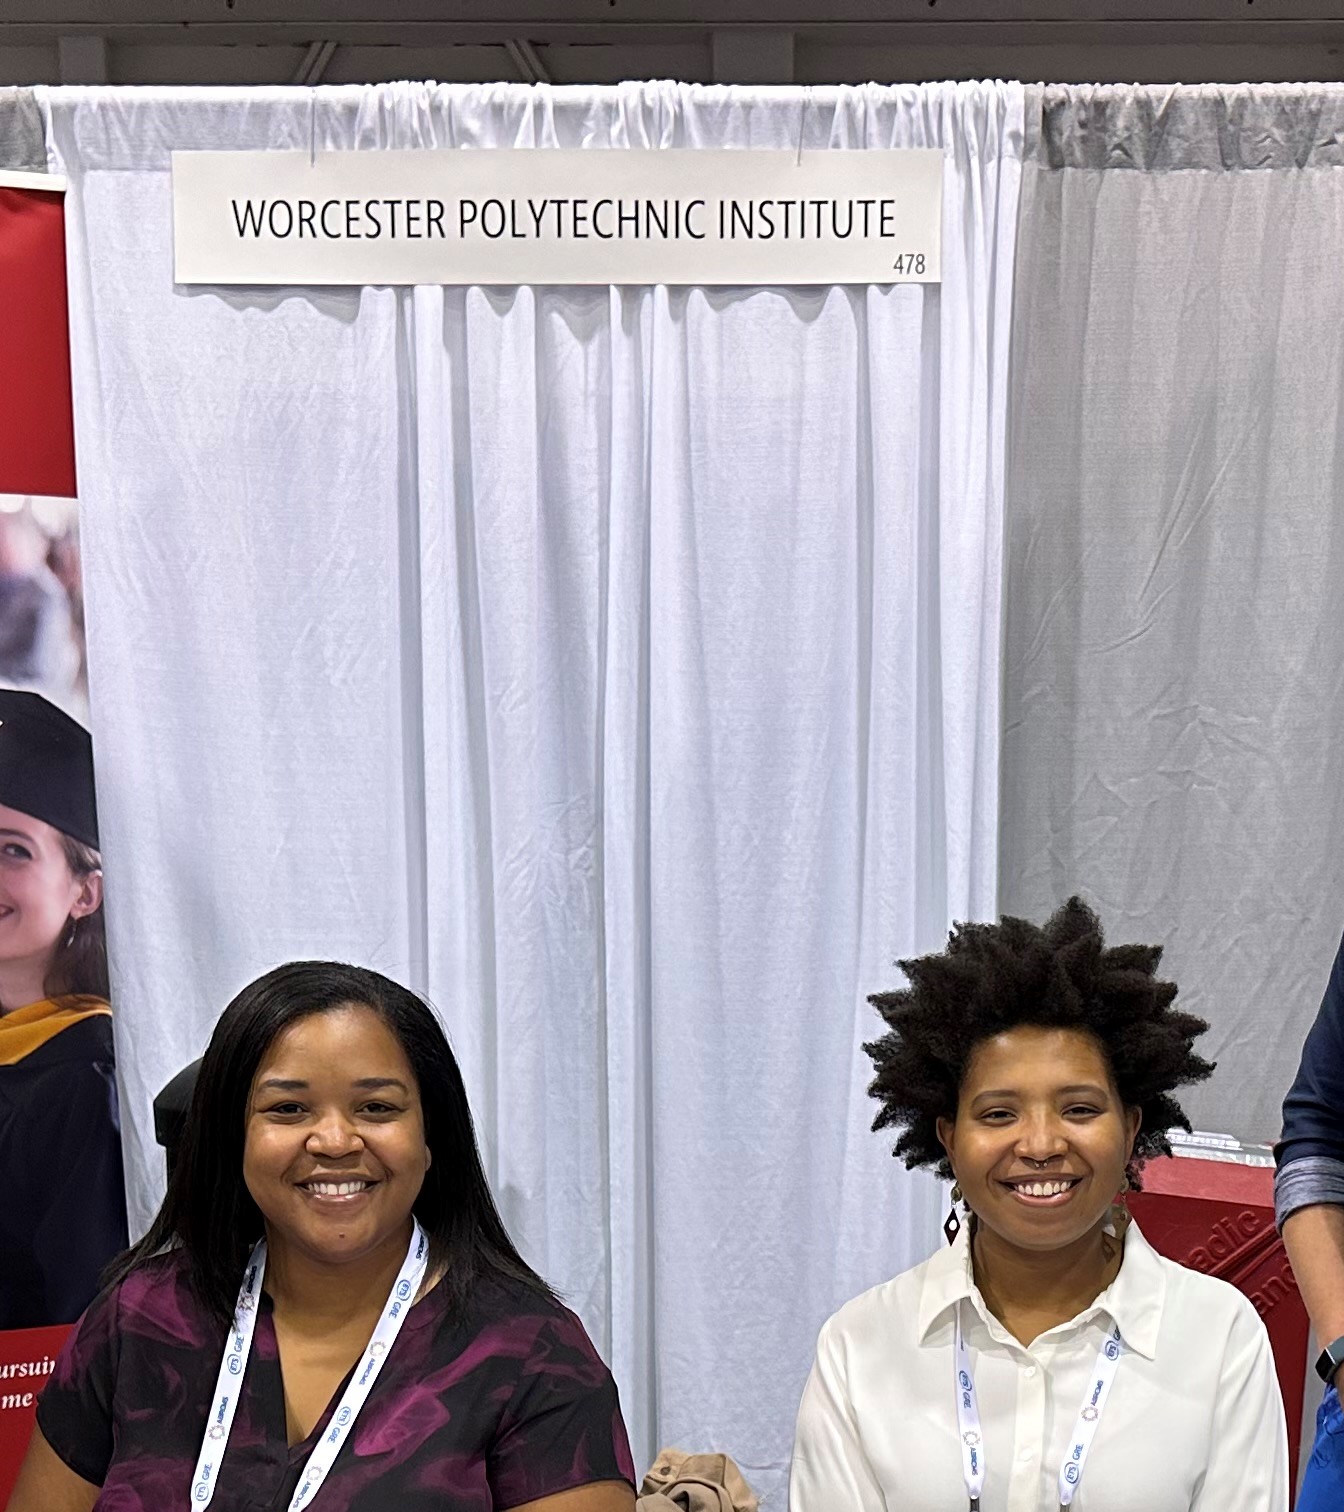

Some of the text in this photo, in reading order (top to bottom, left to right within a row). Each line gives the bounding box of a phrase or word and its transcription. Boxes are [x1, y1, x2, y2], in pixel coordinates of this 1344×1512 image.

[231, 199, 897, 240] WORCESTER POLYTECHNIC INSTITUTE
[892, 253, 927, 276] 478
[388, 1301, 402, 1319] GRE
[0, 1391, 33, 1408] me
